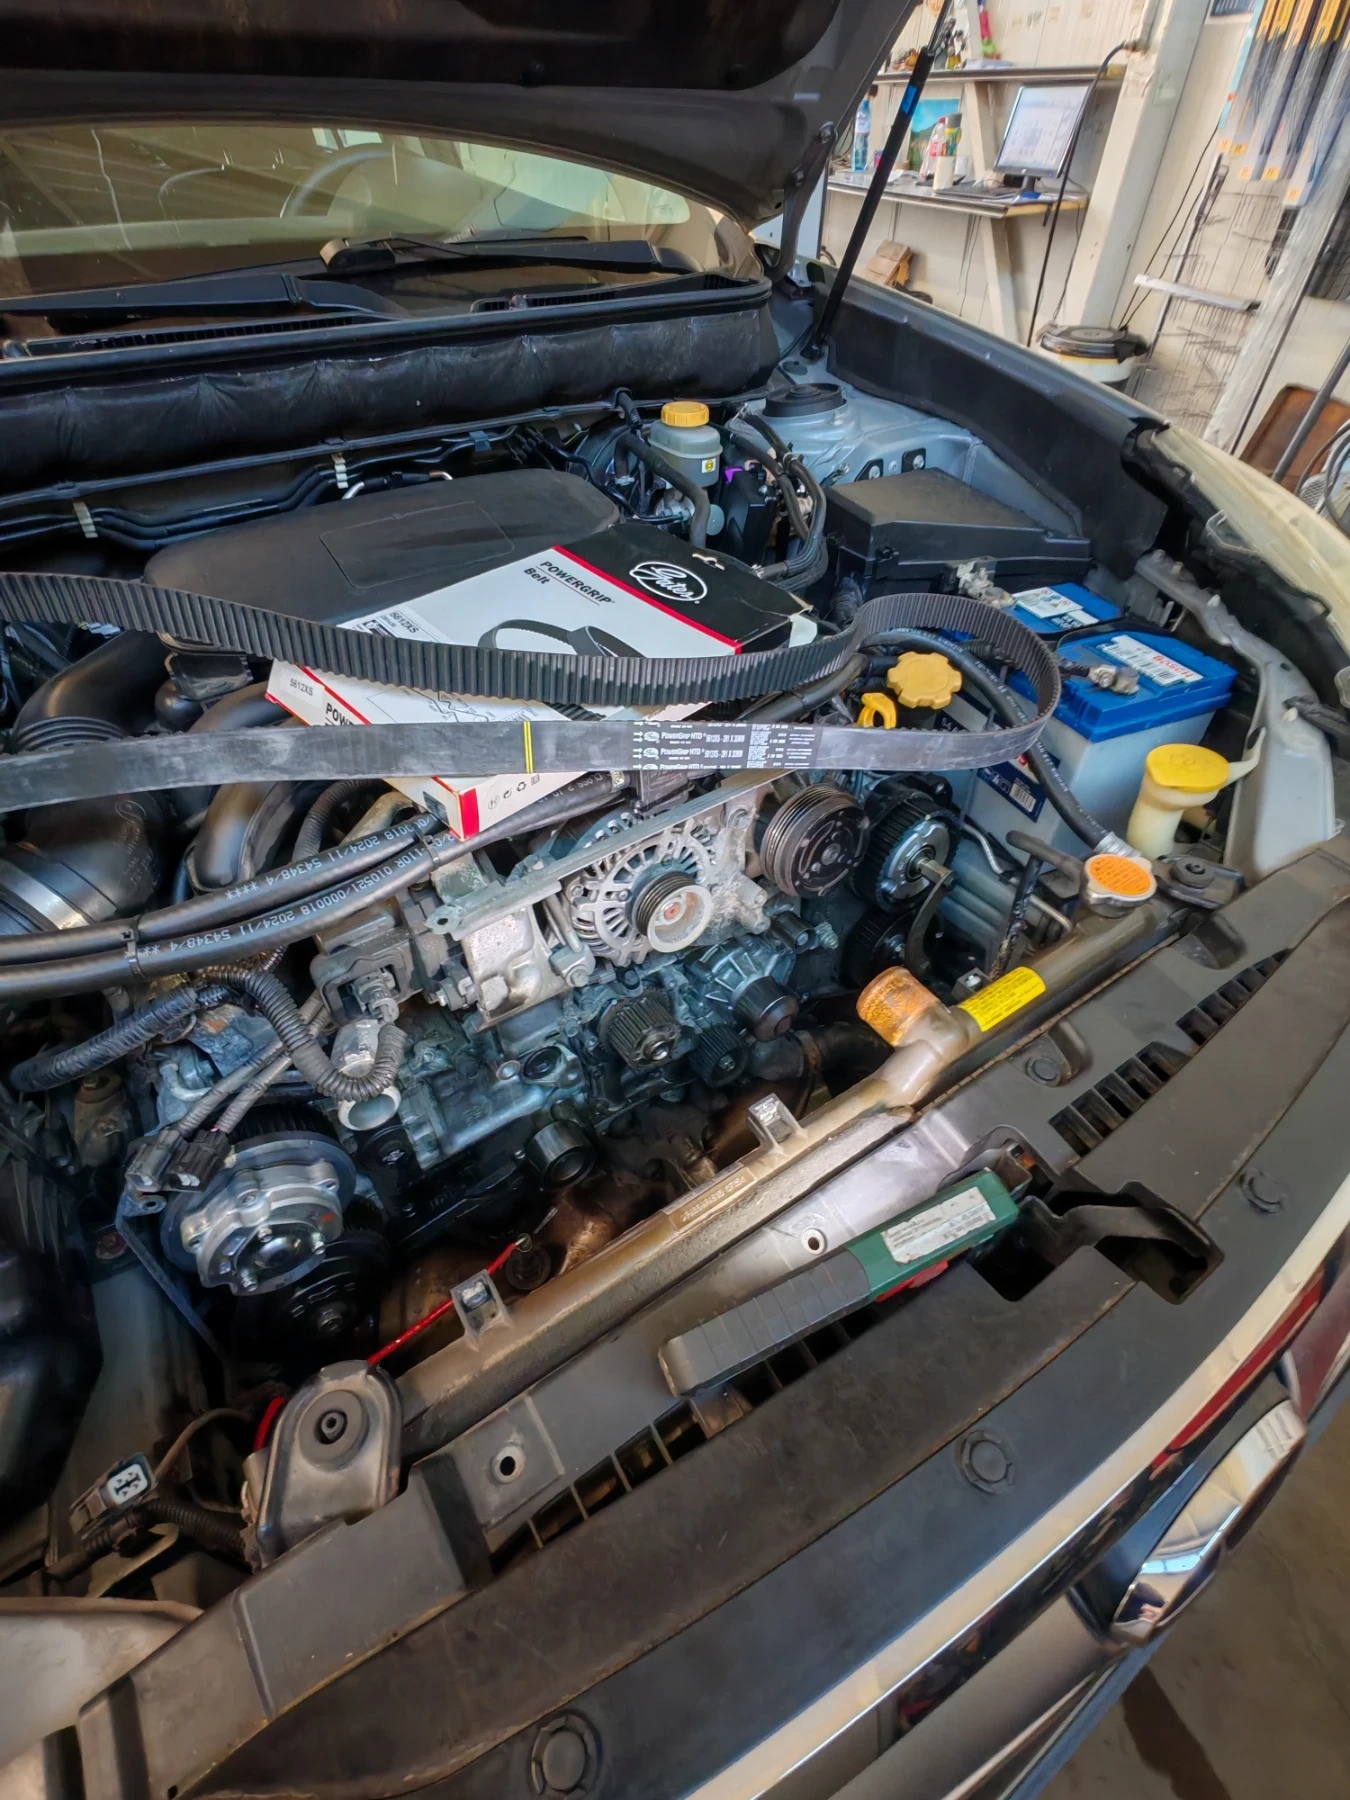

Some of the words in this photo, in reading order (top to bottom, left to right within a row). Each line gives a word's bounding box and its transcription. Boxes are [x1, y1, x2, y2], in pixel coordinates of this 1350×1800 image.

[524, 567, 550, 584] Belt
[540, 561, 612, 603] POWERGRIP
[636, 564, 701, 602] Gates
[290, 678, 314, 696] 5612XS
[326, 703, 354, 726] POW
[328, 835, 381, 862] 2024/11
[266, 857, 322, 886] 54348/4
[300, 866, 393, 916] 010521/000018
[240, 910, 296, 937] 2024/11
[169, 929, 231, 951] 54348/4
